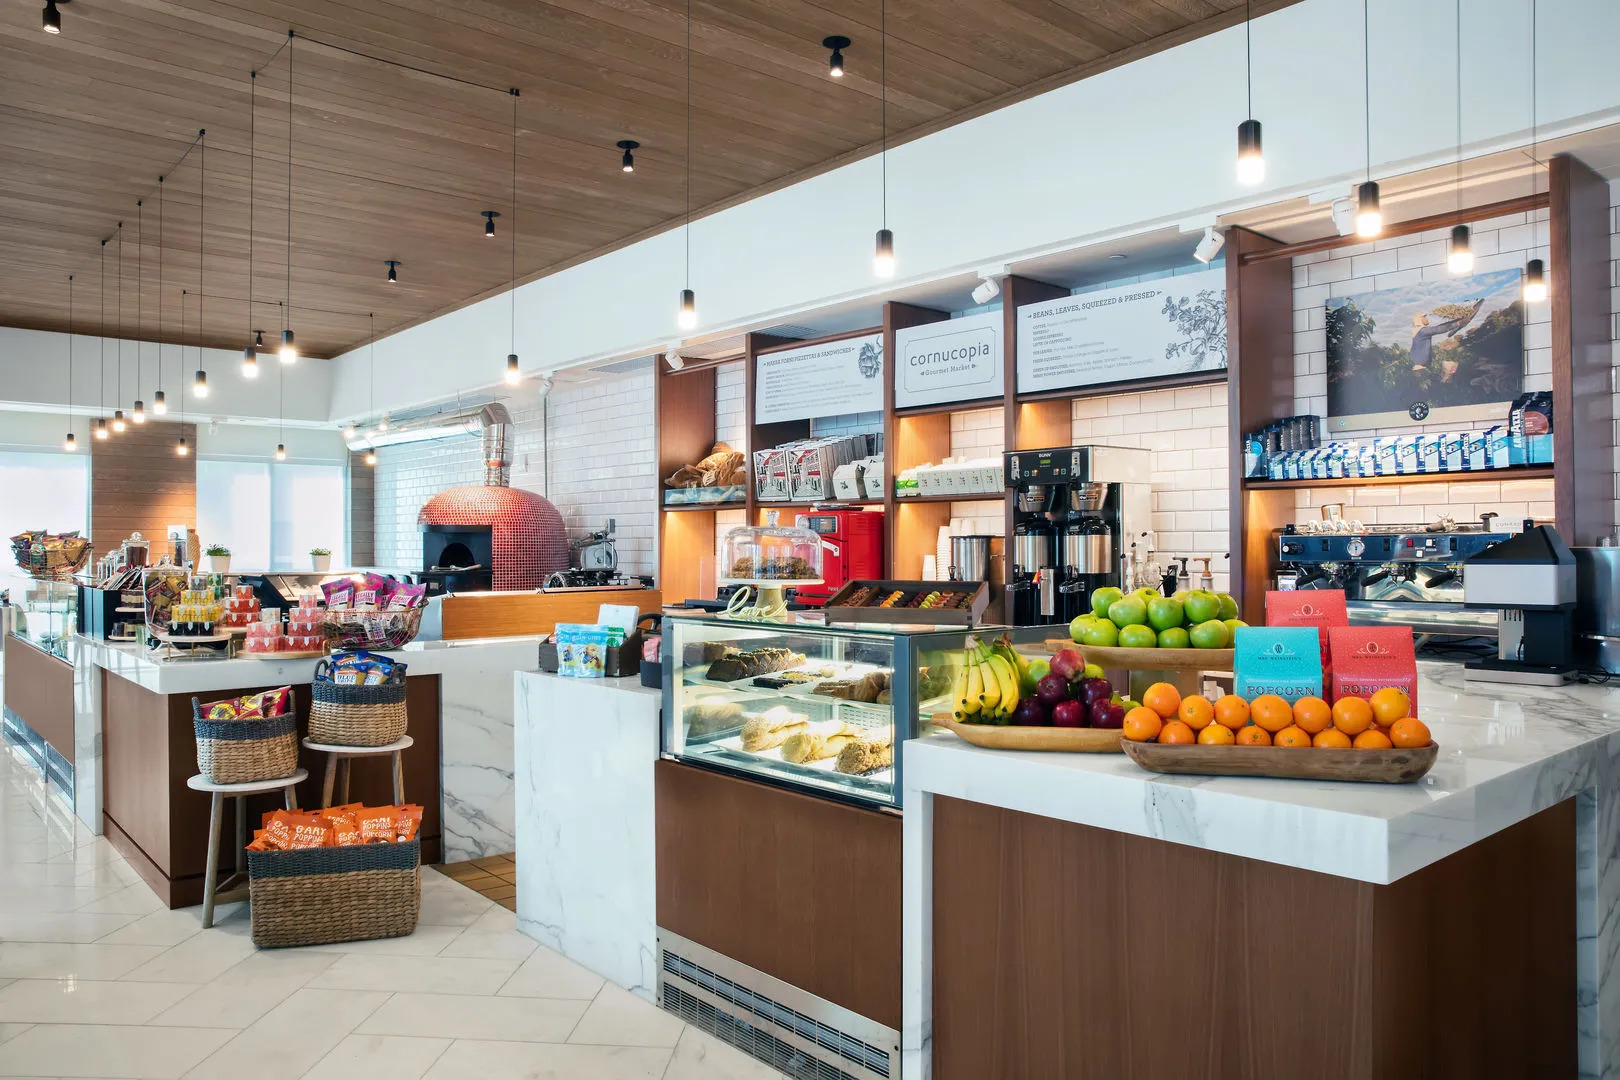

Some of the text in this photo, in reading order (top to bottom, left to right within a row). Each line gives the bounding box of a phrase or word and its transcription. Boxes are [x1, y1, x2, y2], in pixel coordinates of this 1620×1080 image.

[1033, 309, 1054, 319] BEANS,
[1056, 305, 1081, 315] LEAVES,
[1082, 298, 1117, 310] SQUEEZED
[1124, 291, 1155, 302] PRESSED
[910, 342, 989, 366] cornucopia
[925, 368, 948, 376] Gourmet
[1511, 409, 1521, 448] LAVAZZA
[1246, 686, 1315, 696] POPCORN
[1341, 684, 1410, 694] POPCN
[296, 825, 326, 835] GARY
[362, 830, 392, 838] POPCORN
[294, 833, 324, 842] POPPINS
